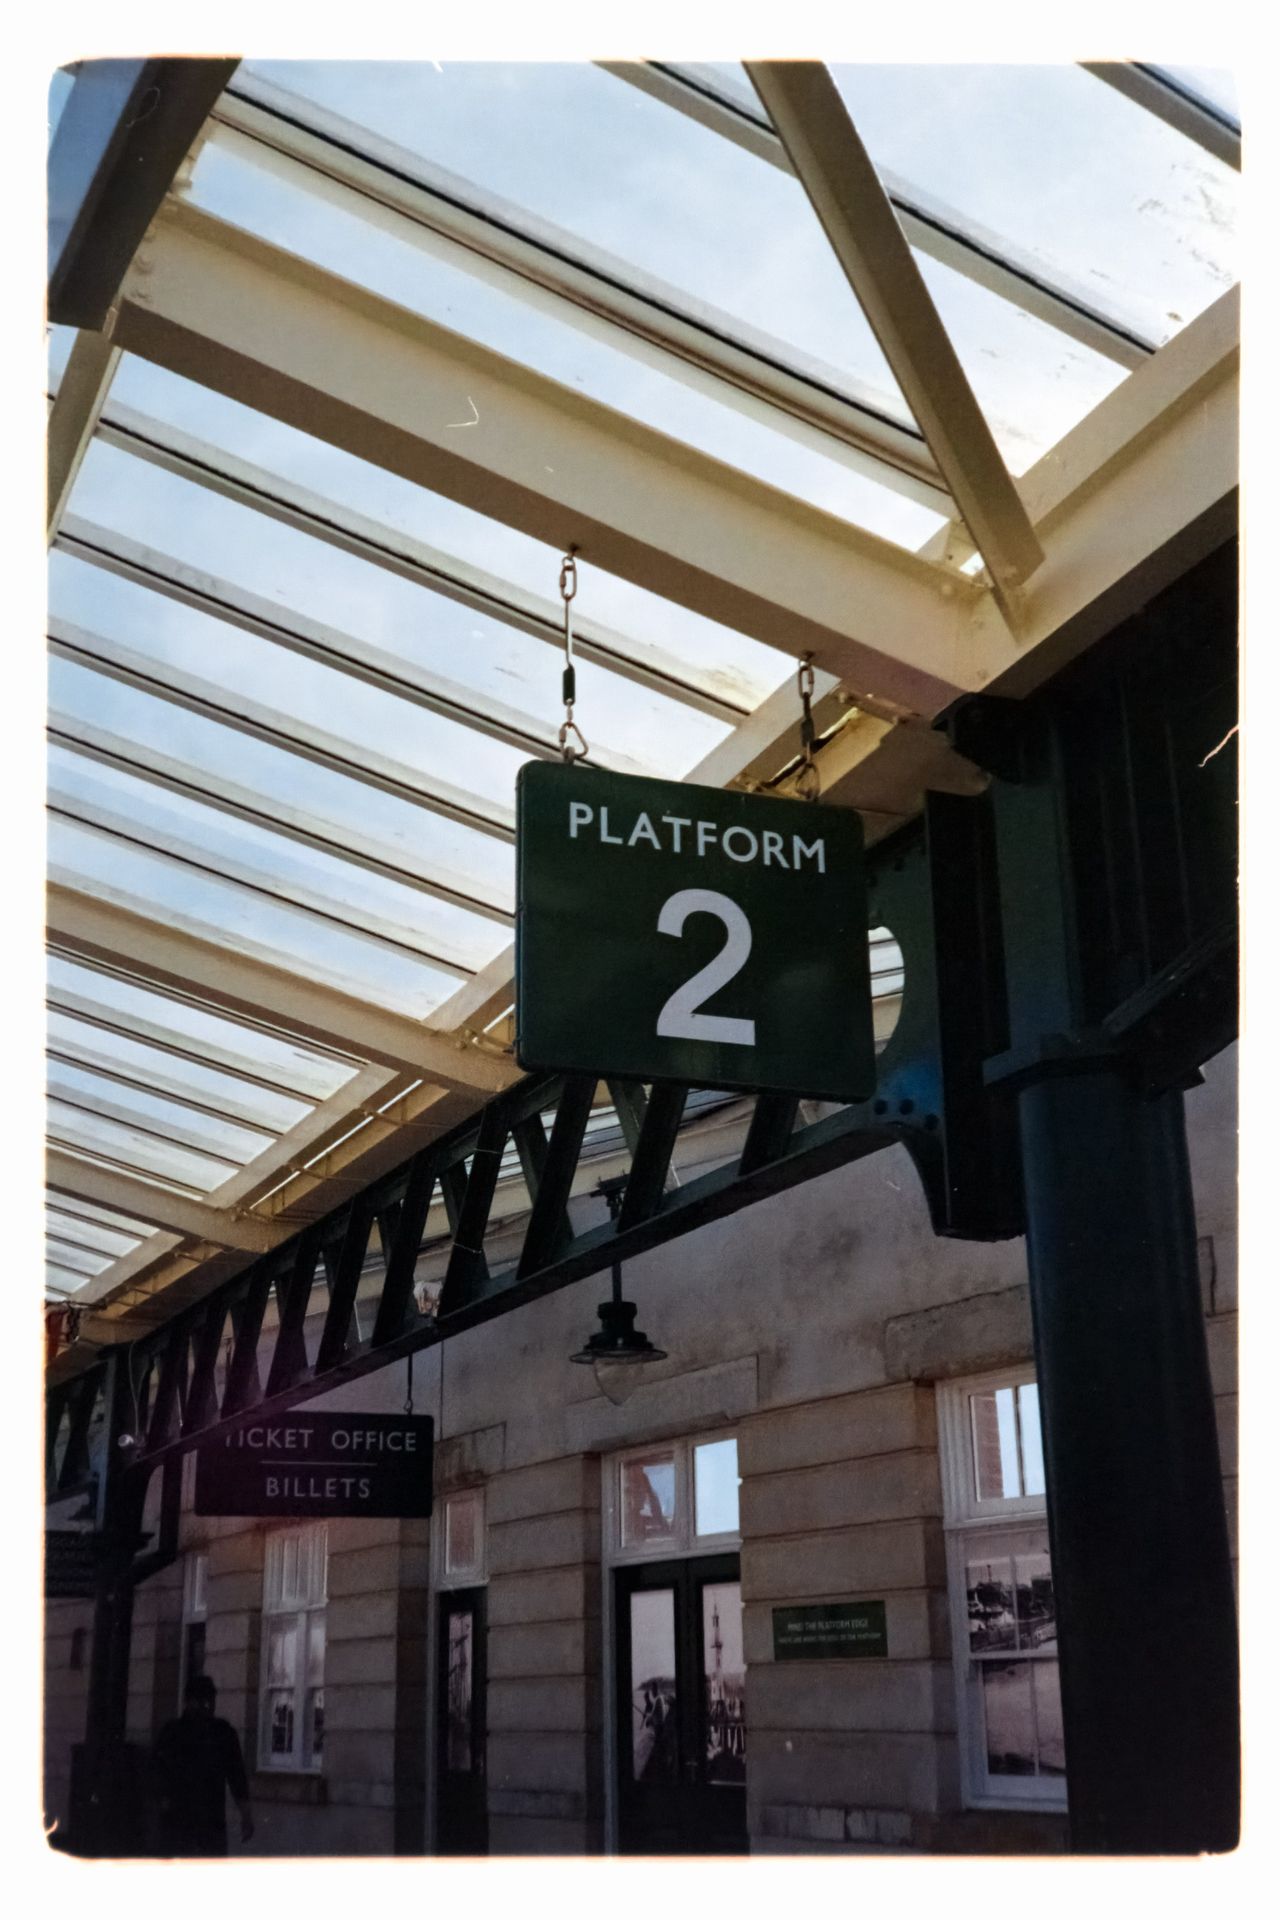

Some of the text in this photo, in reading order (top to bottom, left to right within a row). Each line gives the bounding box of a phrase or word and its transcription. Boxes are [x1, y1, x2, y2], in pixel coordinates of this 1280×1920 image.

[569, 801, 826, 874] PLATFORM
[656, 888, 756, 1046] 2
[331, 1430, 417, 1451] OFFICE
[266, 1477, 370, 1498] BILLETS
